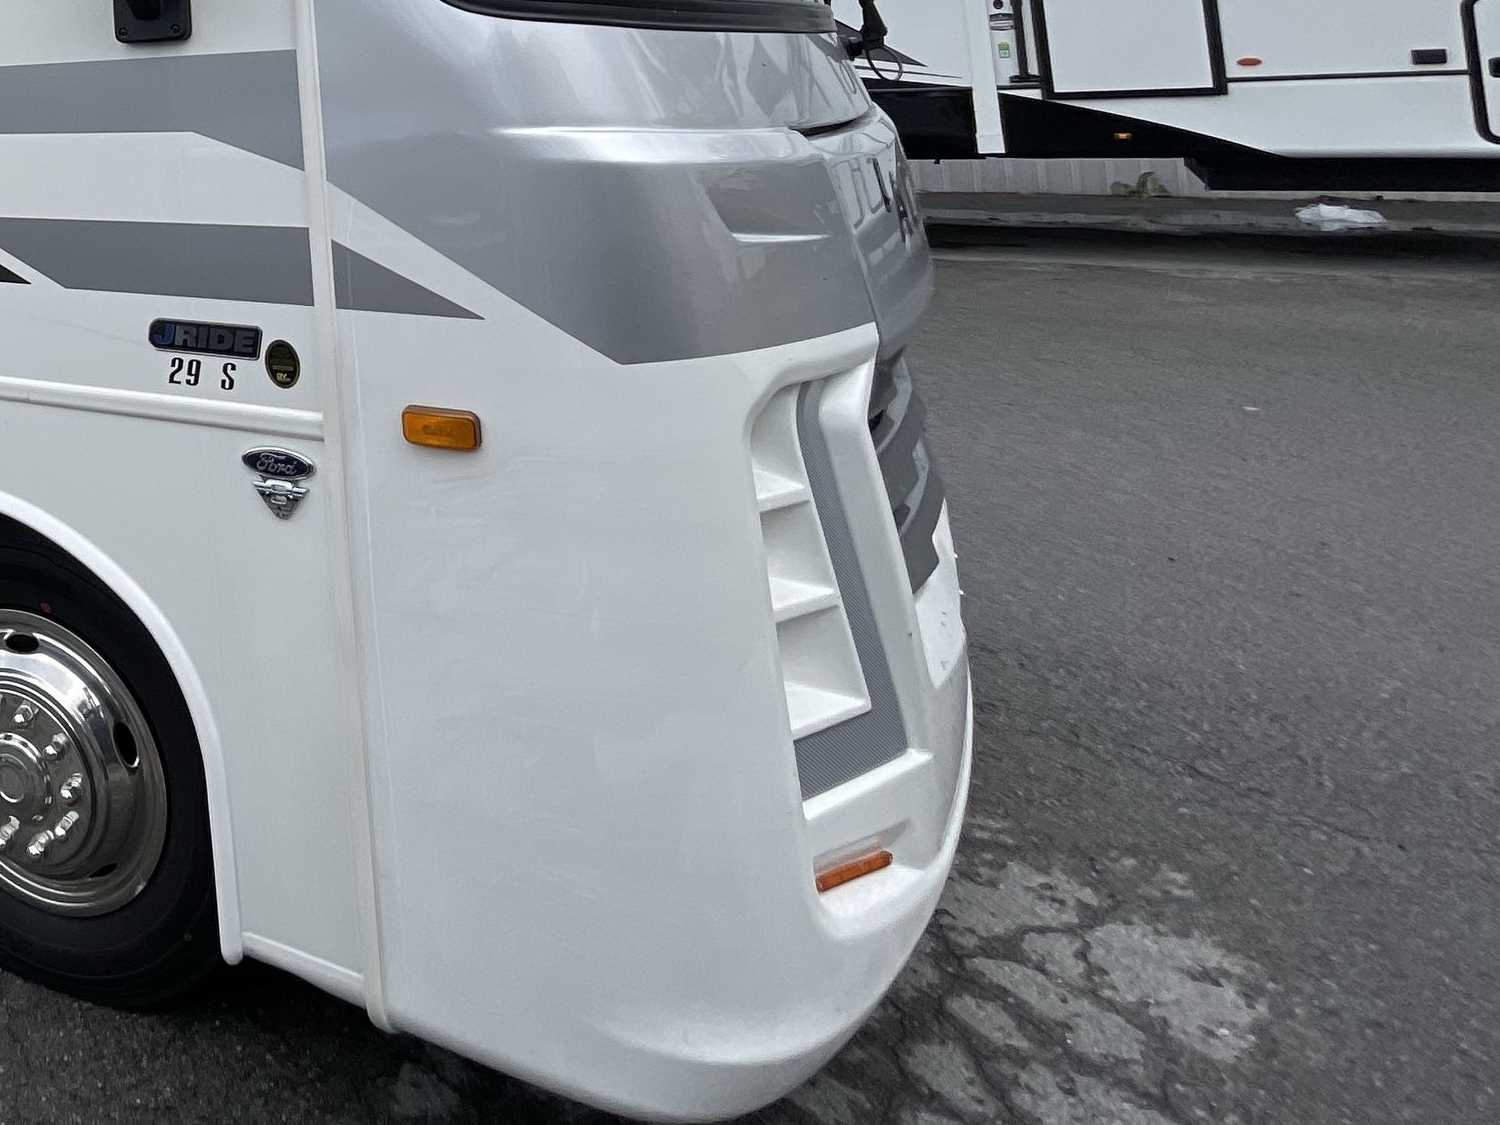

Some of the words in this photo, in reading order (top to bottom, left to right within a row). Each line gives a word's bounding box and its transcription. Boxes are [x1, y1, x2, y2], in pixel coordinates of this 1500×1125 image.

[154, 324, 256, 353] JRIDE
[168, 357, 201, 386] 29
[220, 362, 237, 390] S
[256, 452, 297, 475] Ford
